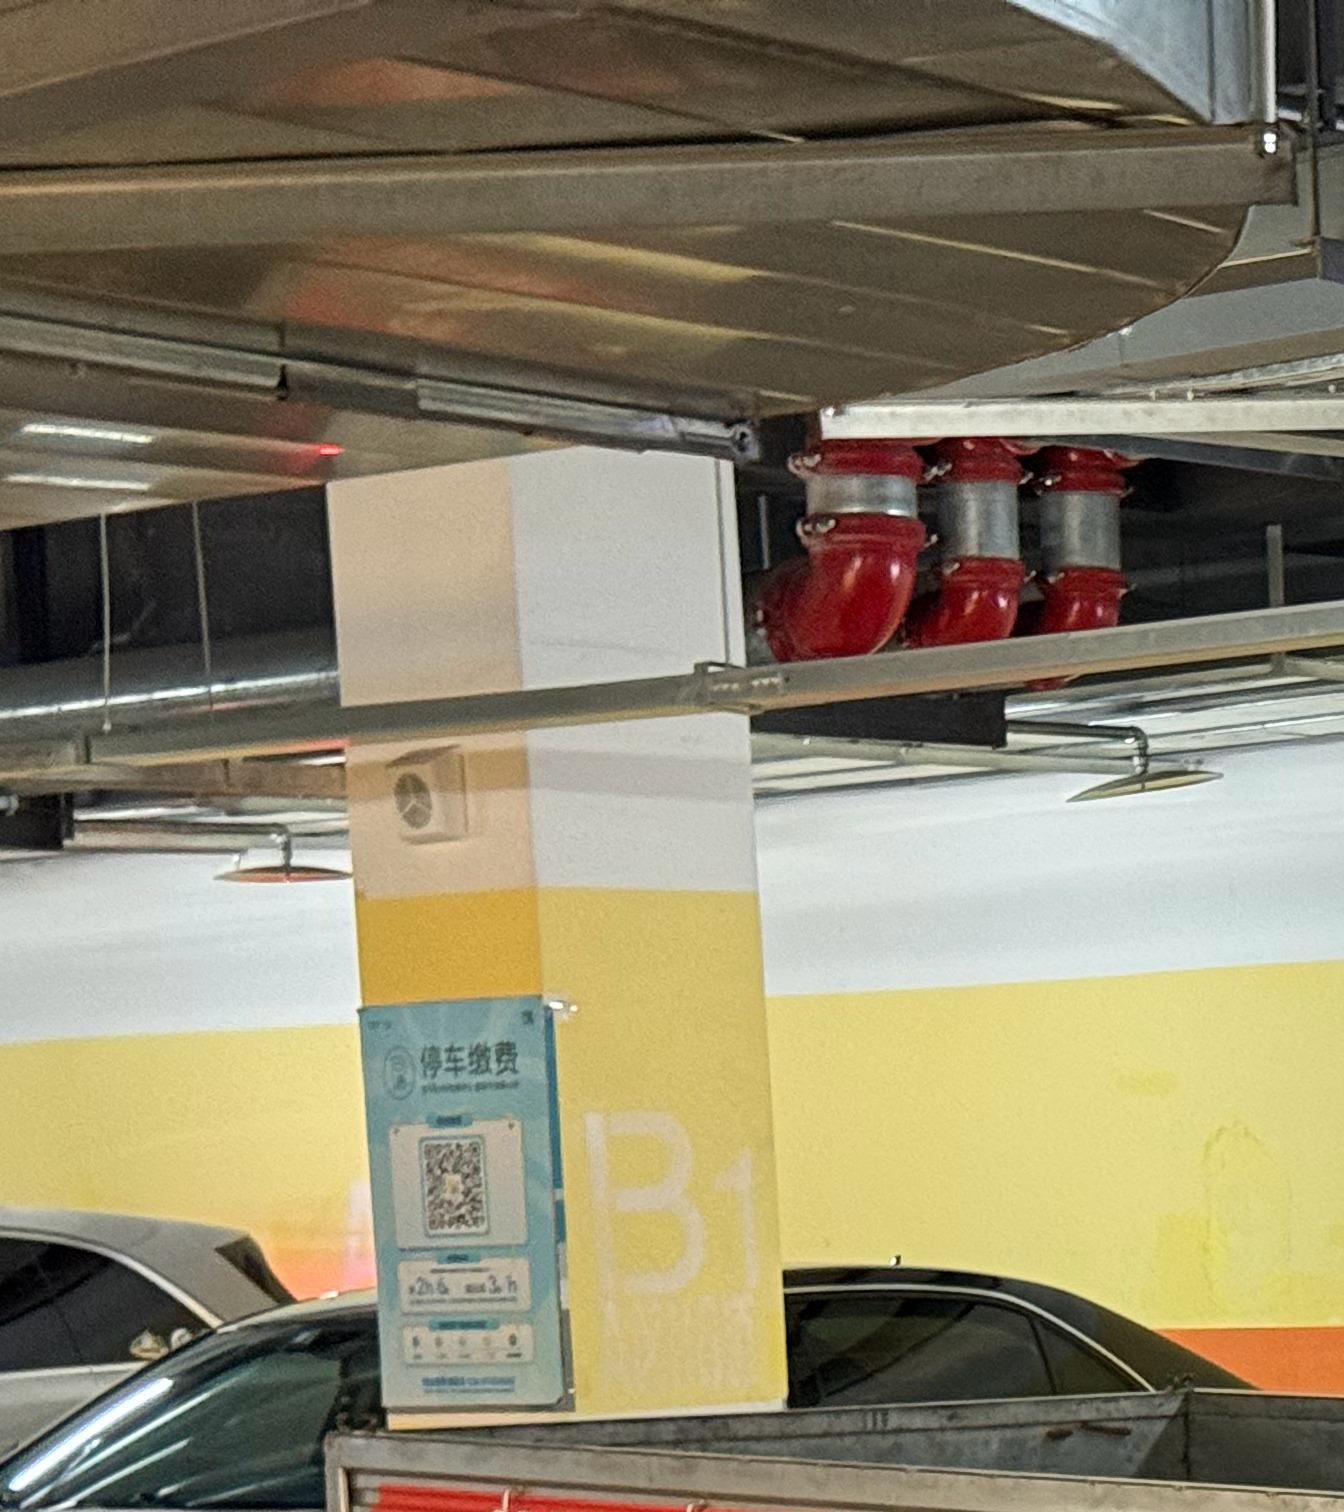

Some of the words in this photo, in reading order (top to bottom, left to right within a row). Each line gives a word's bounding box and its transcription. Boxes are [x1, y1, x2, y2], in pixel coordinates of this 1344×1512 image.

[420, 1040, 519, 1079] 停车缴费
[584, 1108, 757, 1296] B1
